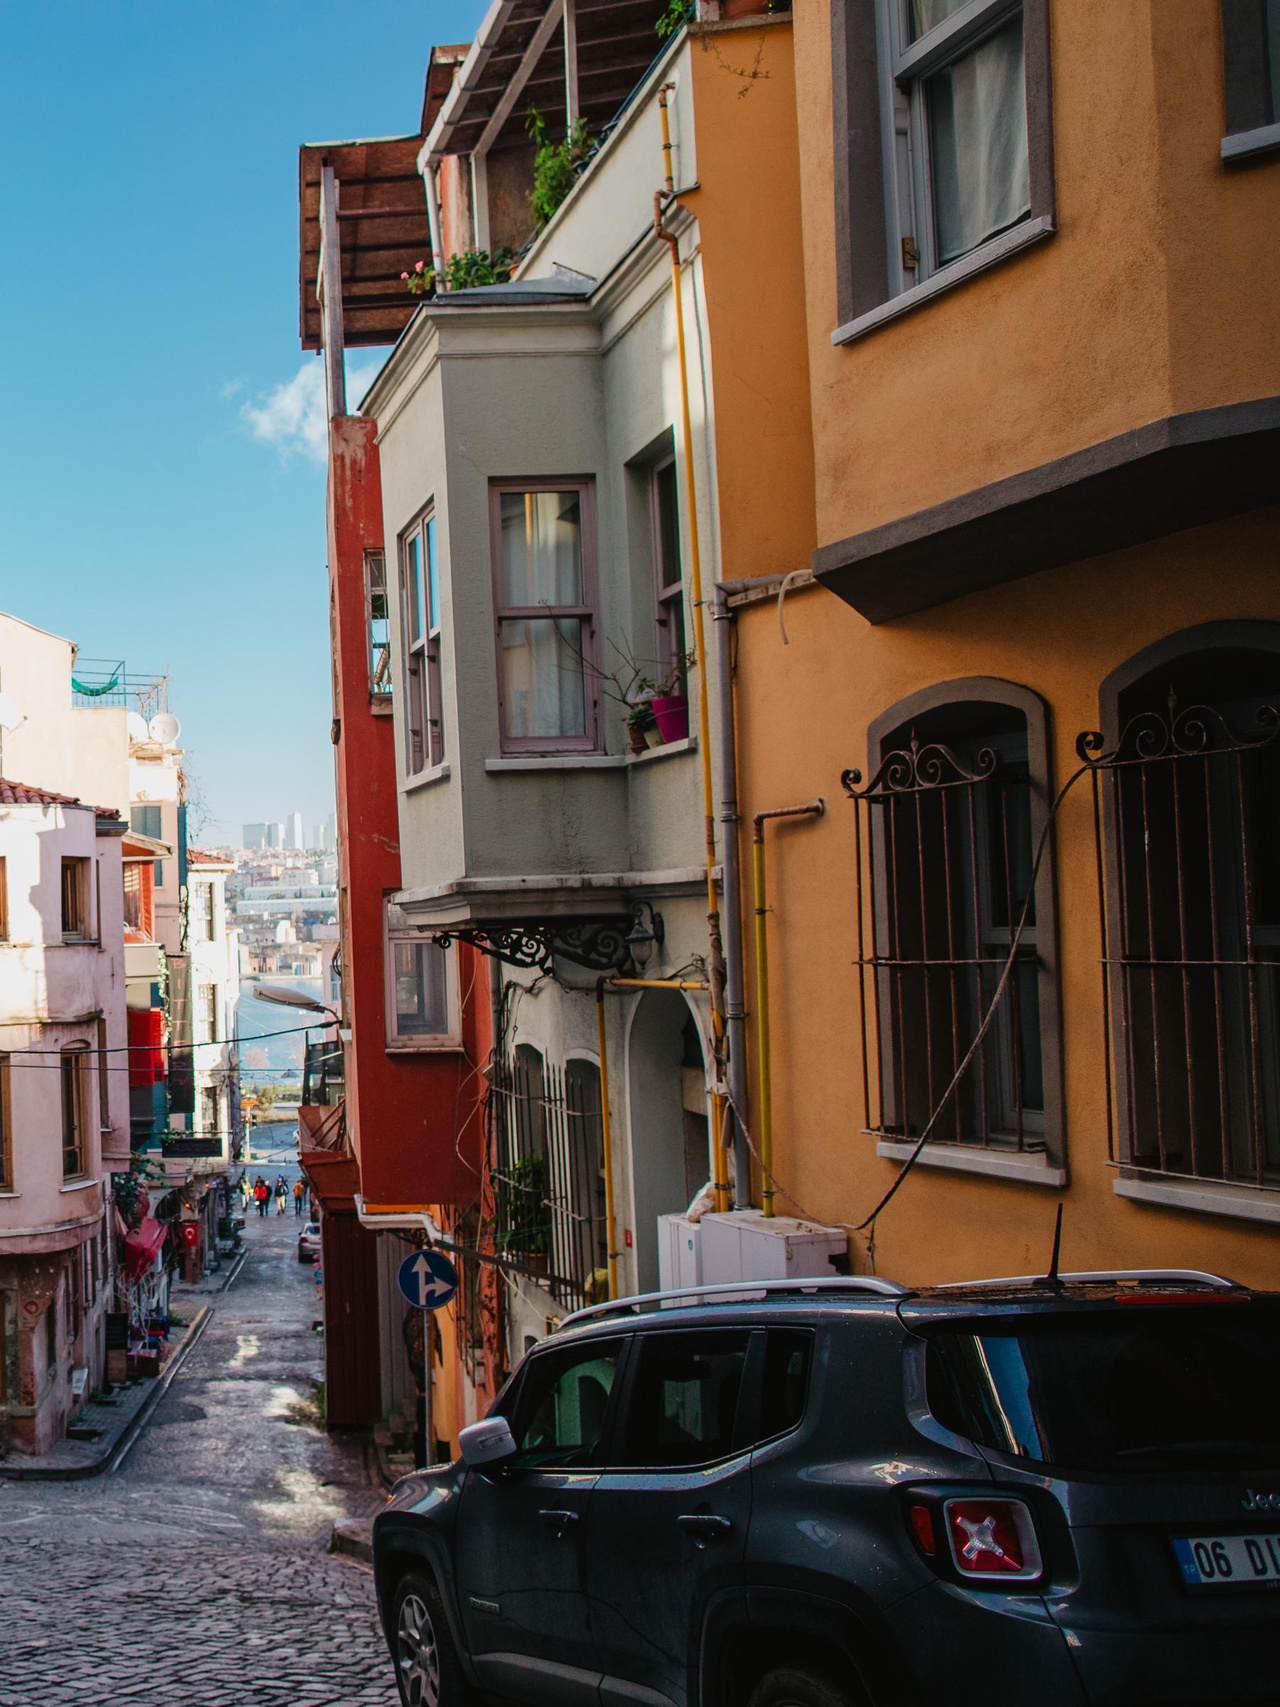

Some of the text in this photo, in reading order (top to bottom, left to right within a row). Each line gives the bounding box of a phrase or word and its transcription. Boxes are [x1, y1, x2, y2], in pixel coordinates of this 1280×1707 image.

[1182, 1565, 1197, 1575] TR
[1194, 1538, 1280, 1578] 06 DI
